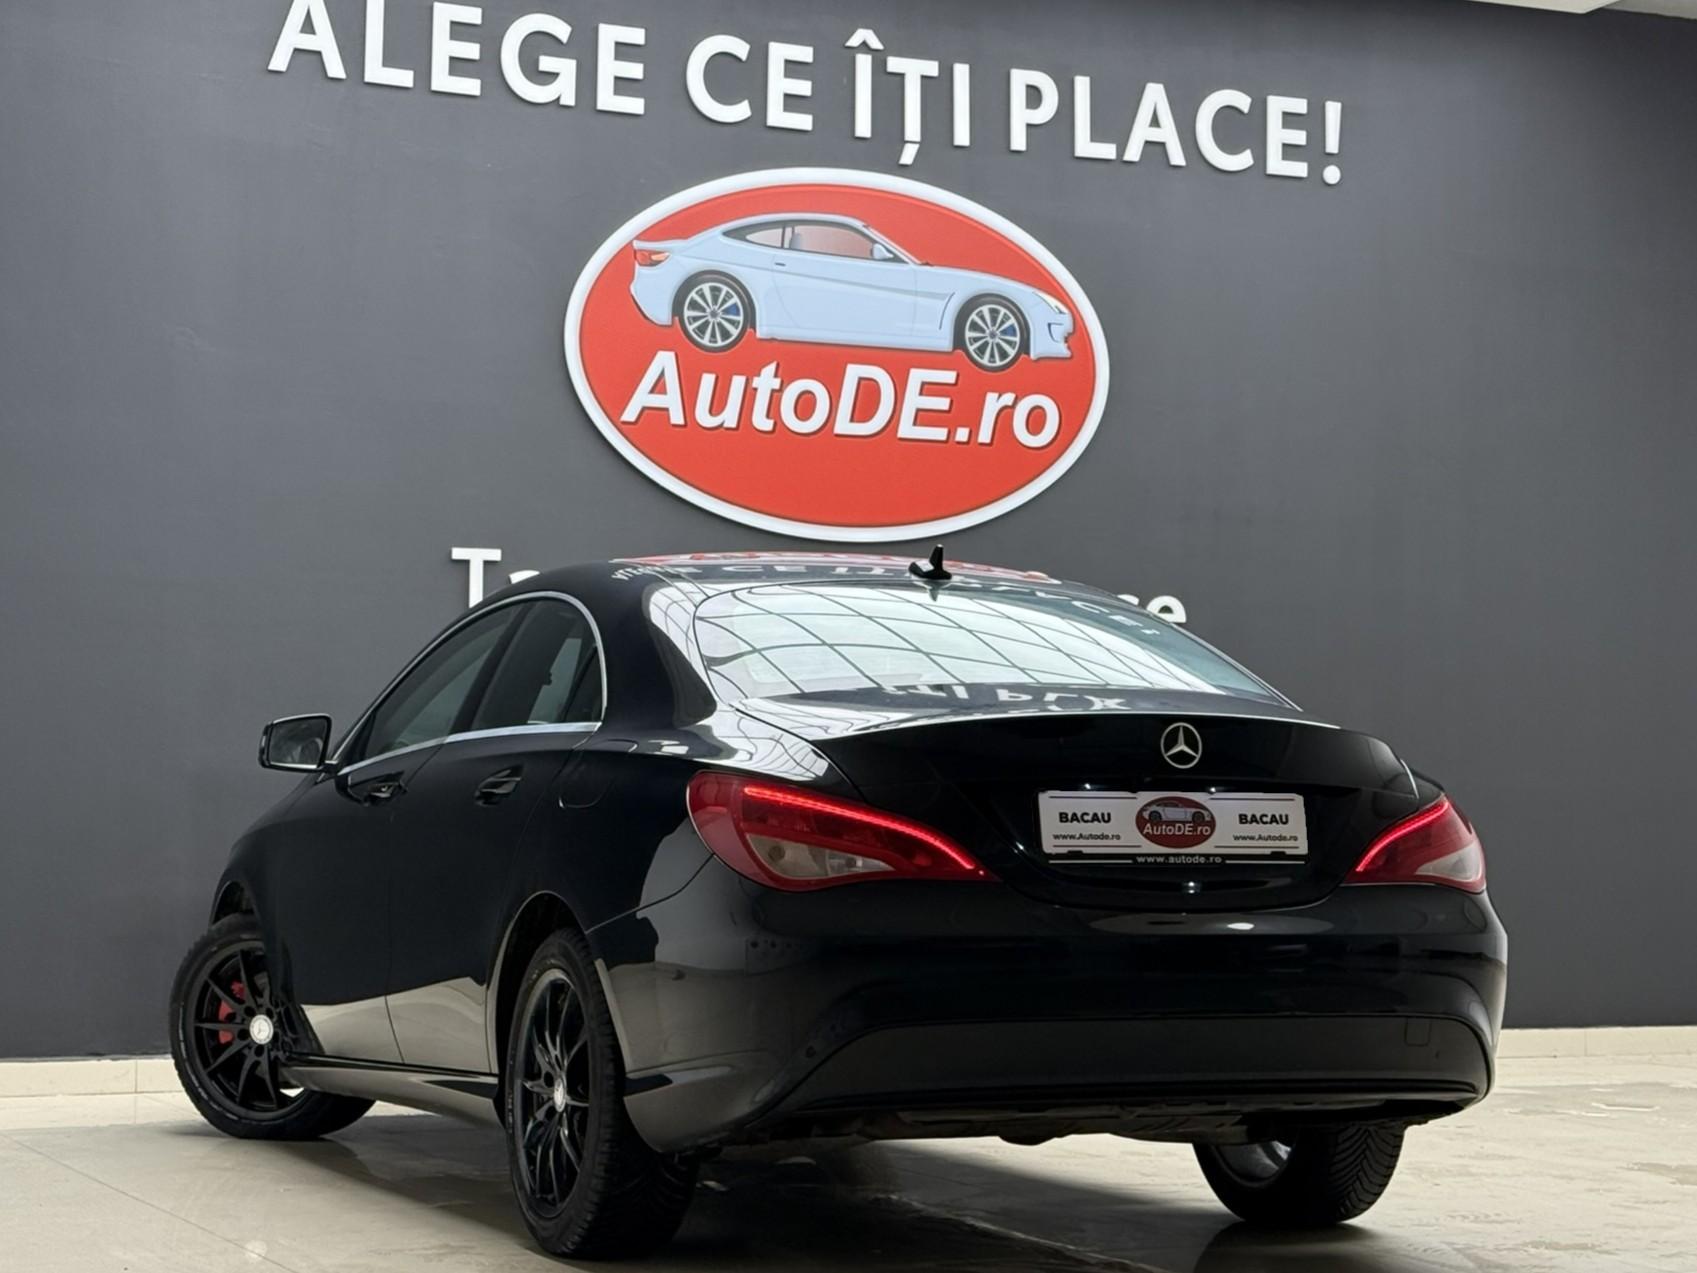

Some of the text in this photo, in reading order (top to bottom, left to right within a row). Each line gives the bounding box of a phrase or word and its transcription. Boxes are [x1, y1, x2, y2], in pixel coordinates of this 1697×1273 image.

[267, 0, 1343, 185] ALEGE CE ÎȚI PLACE!
[620, 350, 1061, 449] AutoDE.ro
[1058, 811, 1112, 824] BACAU
[1238, 813, 1290, 825] BACAU
[1143, 822, 1212, 837] AutoDE.ro
[1052, 833, 1121, 841] www.Autode.ro
[1232, 833, 1299, 842] www.Autode.ro
[1136, 855, 1223, 864] www.autode.ro
